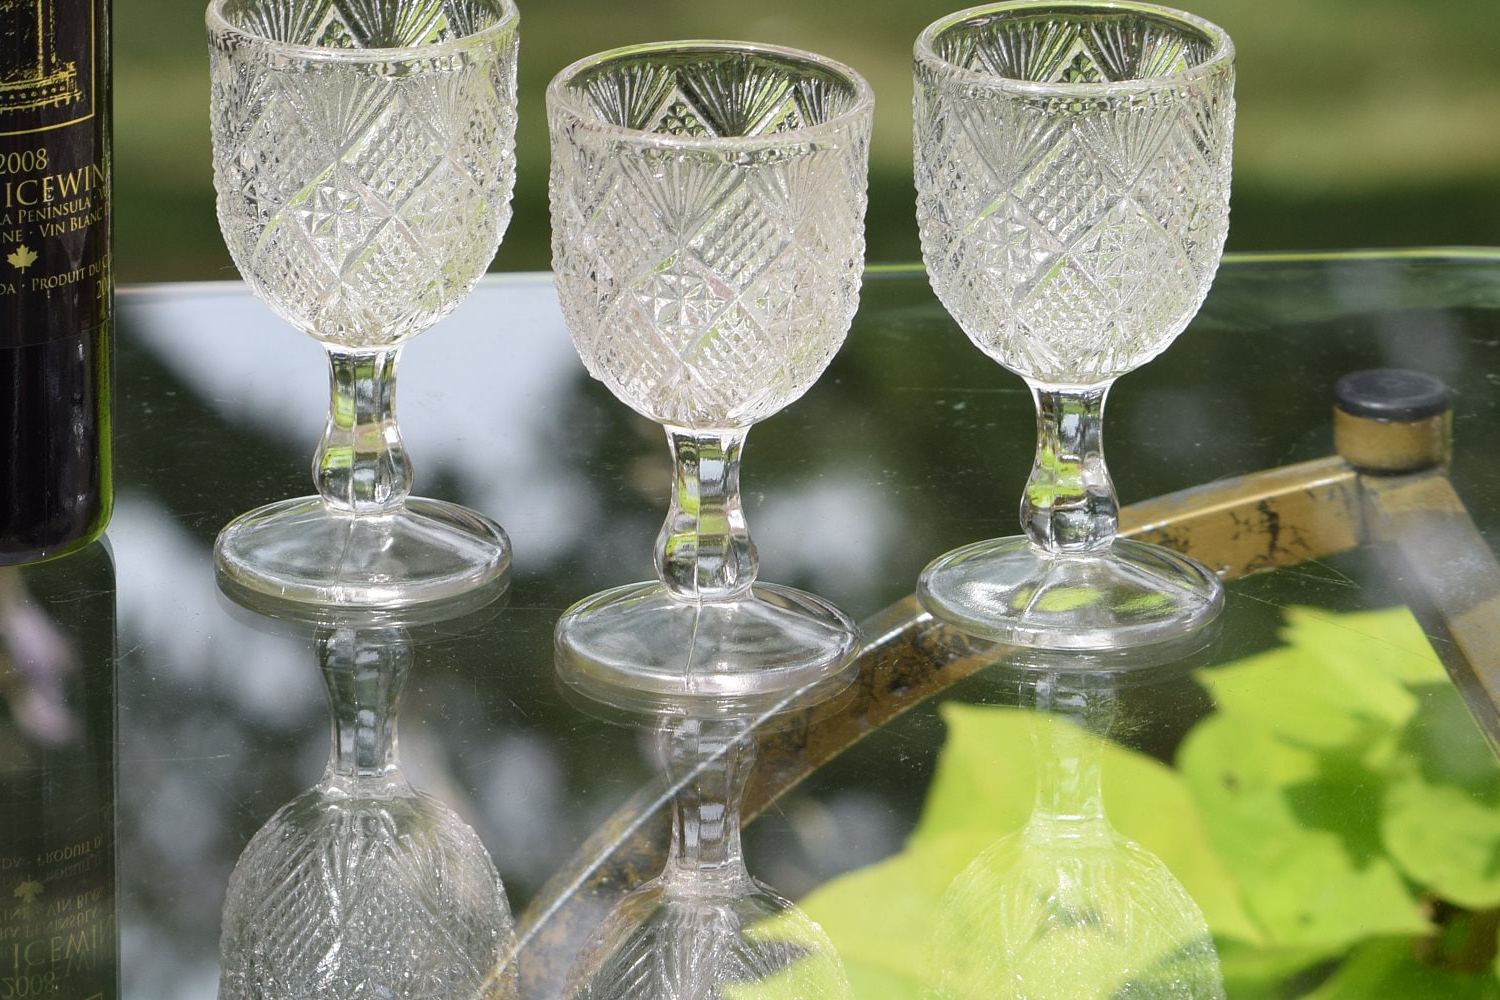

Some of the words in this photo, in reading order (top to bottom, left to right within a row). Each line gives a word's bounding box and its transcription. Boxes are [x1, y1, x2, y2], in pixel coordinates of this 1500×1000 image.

[5, 162, 109, 208] ICEWIN
[17, 196, 92, 225] PENINSULA
[38, 221, 66, 240] VIN
[70, 206, 103, 233] BLANC
[31, 267, 86, 292] PRODUIT
